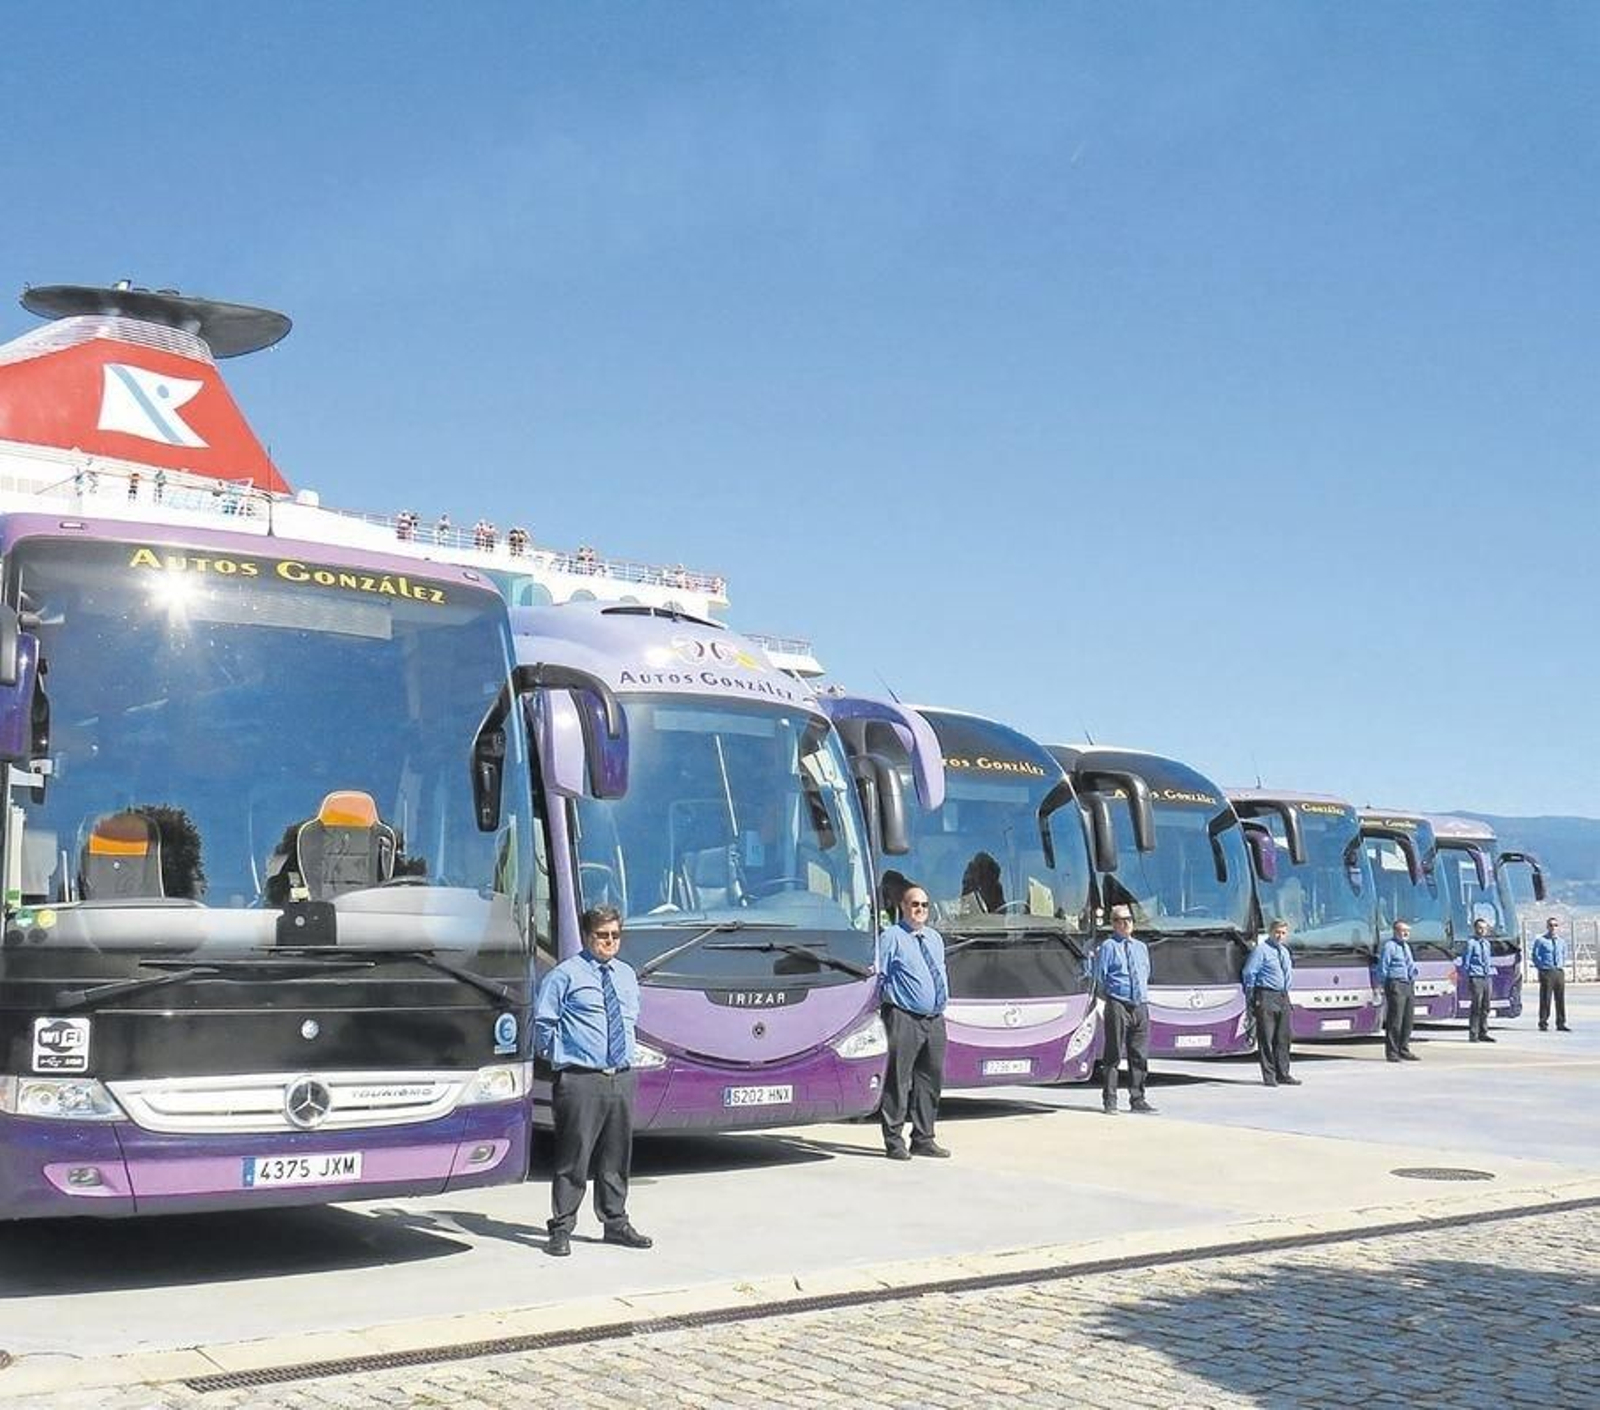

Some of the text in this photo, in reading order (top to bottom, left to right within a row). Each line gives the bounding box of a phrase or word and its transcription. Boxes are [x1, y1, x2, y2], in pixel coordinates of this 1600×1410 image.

[728, 992, 786, 1005] IRIZAR
[260, 1157, 355, 1180] 4375 JXM
